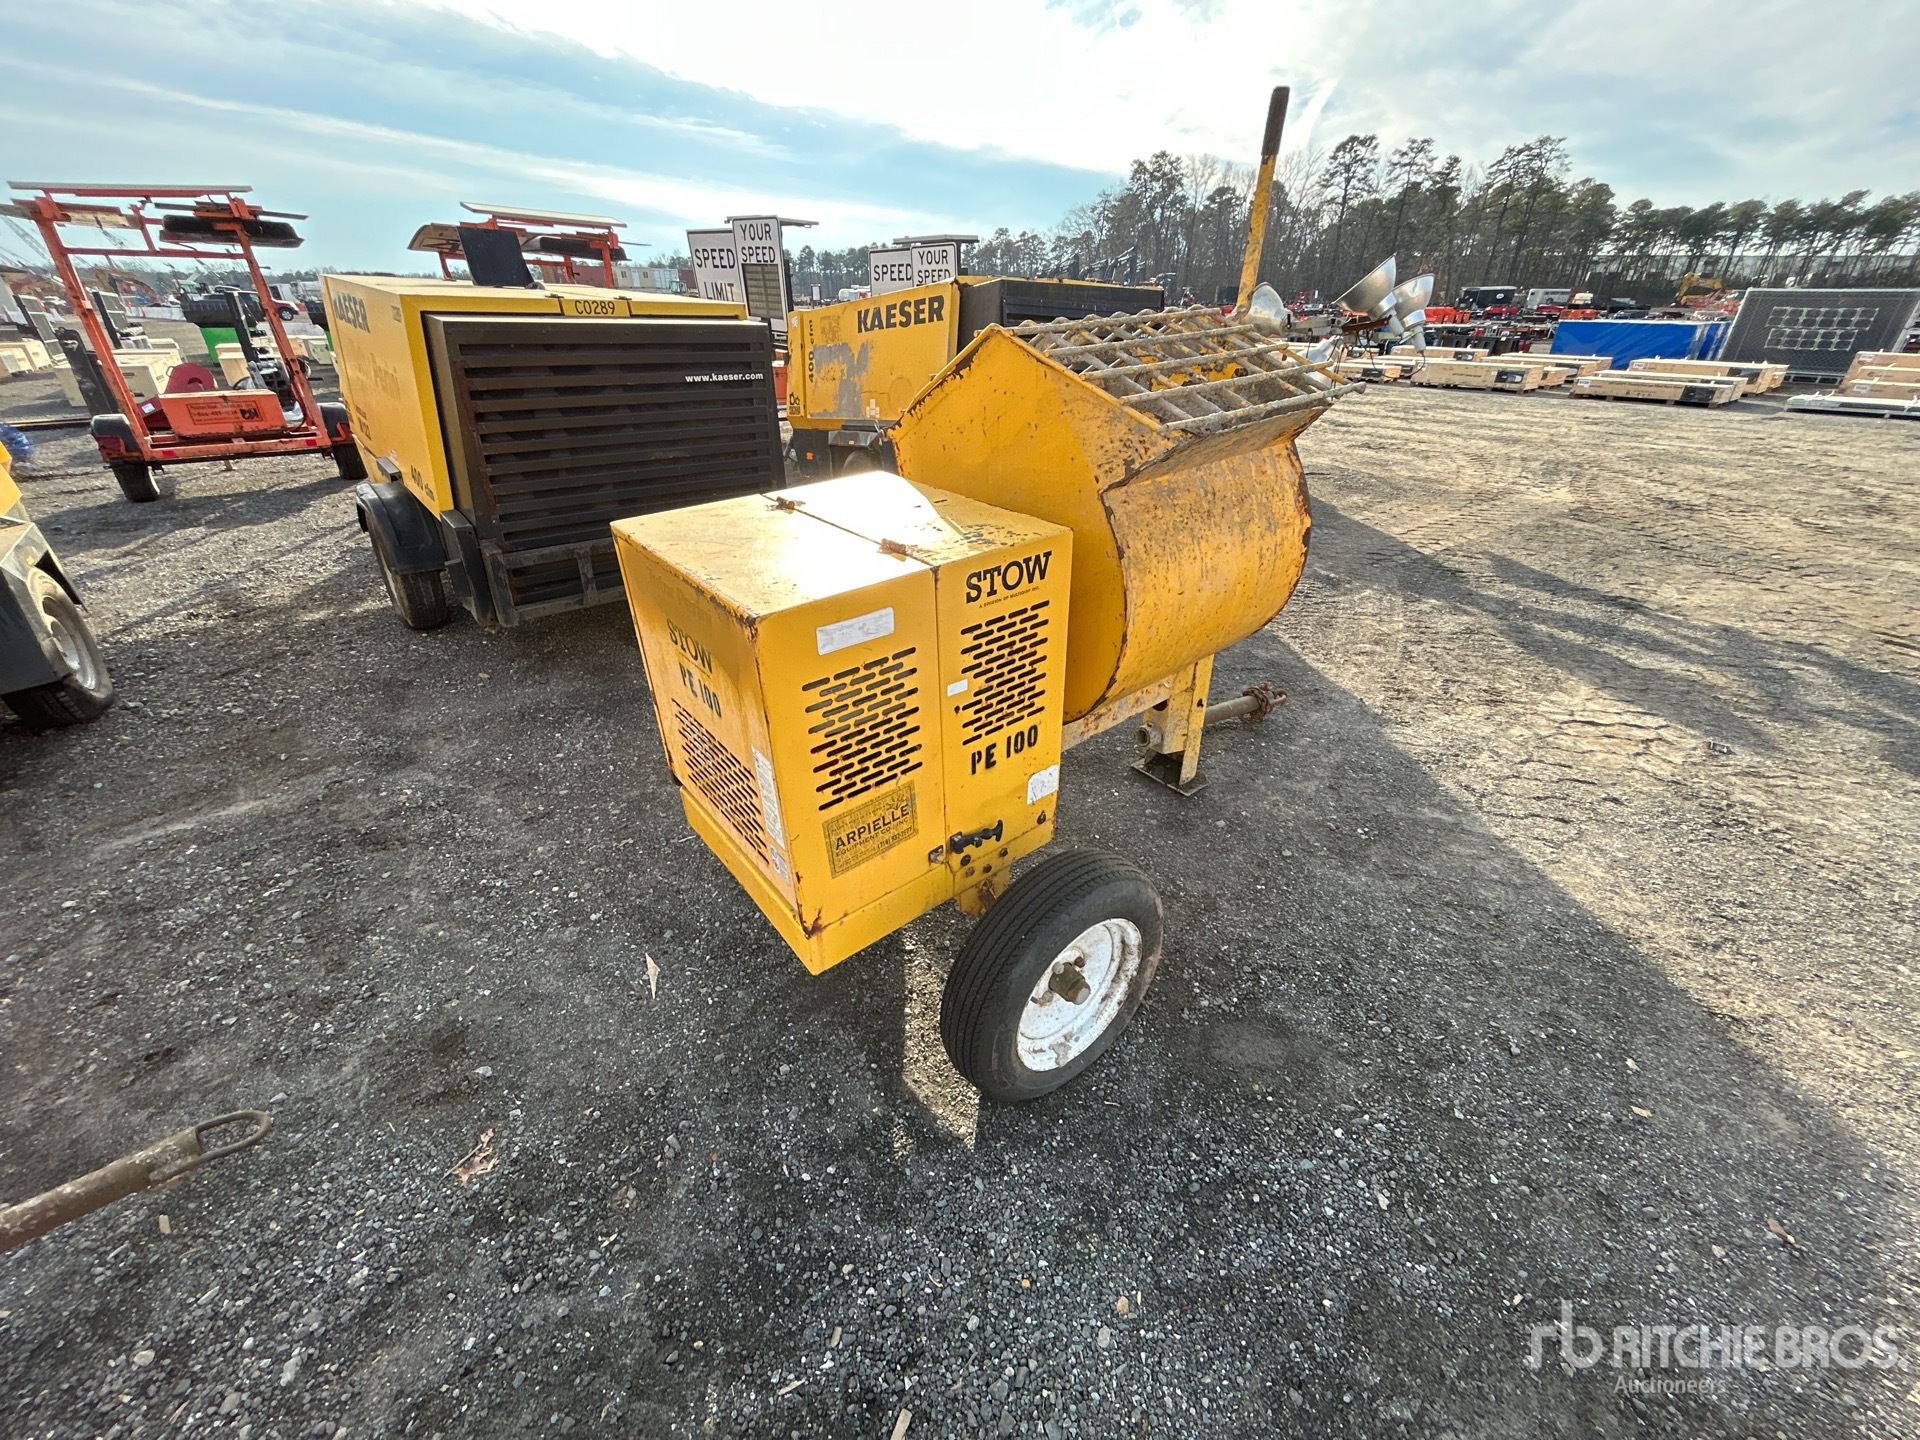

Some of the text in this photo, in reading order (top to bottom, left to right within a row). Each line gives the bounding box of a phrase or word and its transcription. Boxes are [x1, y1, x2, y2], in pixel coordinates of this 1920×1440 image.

[740, 223, 772, 241] YOUR
[694, 248, 735, 269] SPEED
[741, 246, 775, 263] SPEED
[918, 249, 948, 265] YOUR
[873, 263, 912, 282] SPEED
[917, 269, 951, 284] SPEED
[704, 281, 735, 302] LIMIT
[857, 295, 945, 334] KAESER
[685, 372, 764, 383] www.kaeser.com
[965, 550, 1052, 604] STOW
[666, 618, 712, 674] STOW
[679, 662, 698, 698] PE
[698, 678, 722, 718] 100
[971, 724, 1038, 776] PE 100
[835, 804, 910, 851] ARPIELLE
[835, 831, 880, 858] EQUIPMENT
